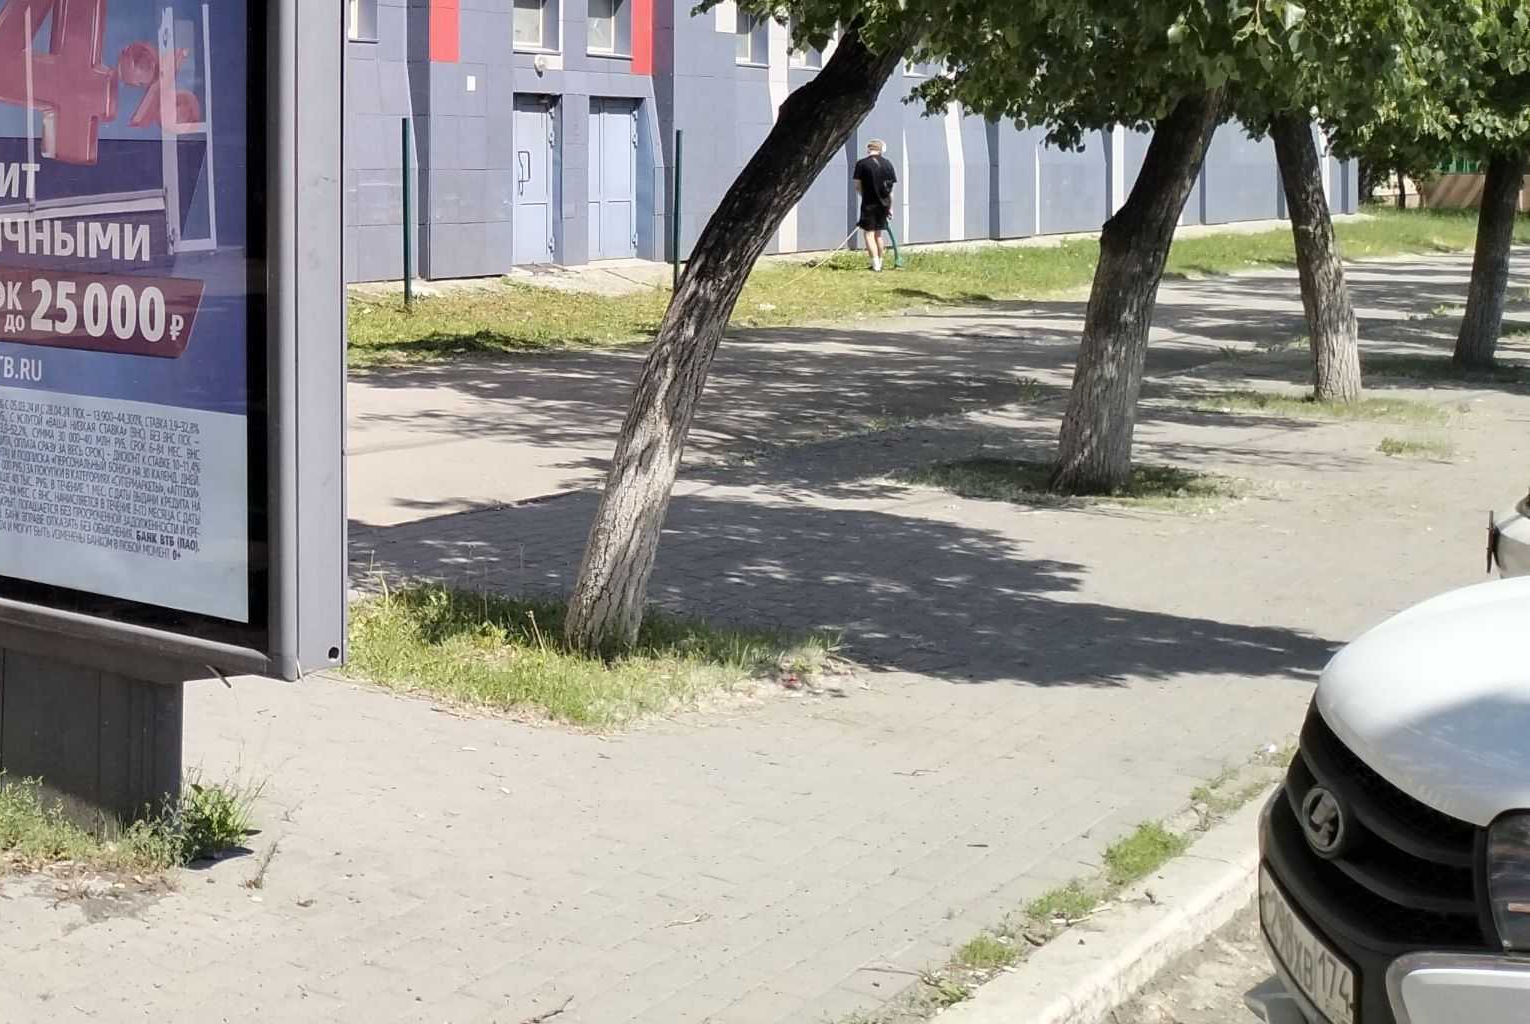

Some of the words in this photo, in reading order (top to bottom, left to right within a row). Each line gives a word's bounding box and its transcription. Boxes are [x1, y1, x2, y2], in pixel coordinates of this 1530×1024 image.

[4, 314, 26, 333] ДО
[136, 529, 156, 543] БАНК
[159, 533, 174, 546] ВТБ
[1318, 949, 1350, 1014] 174
